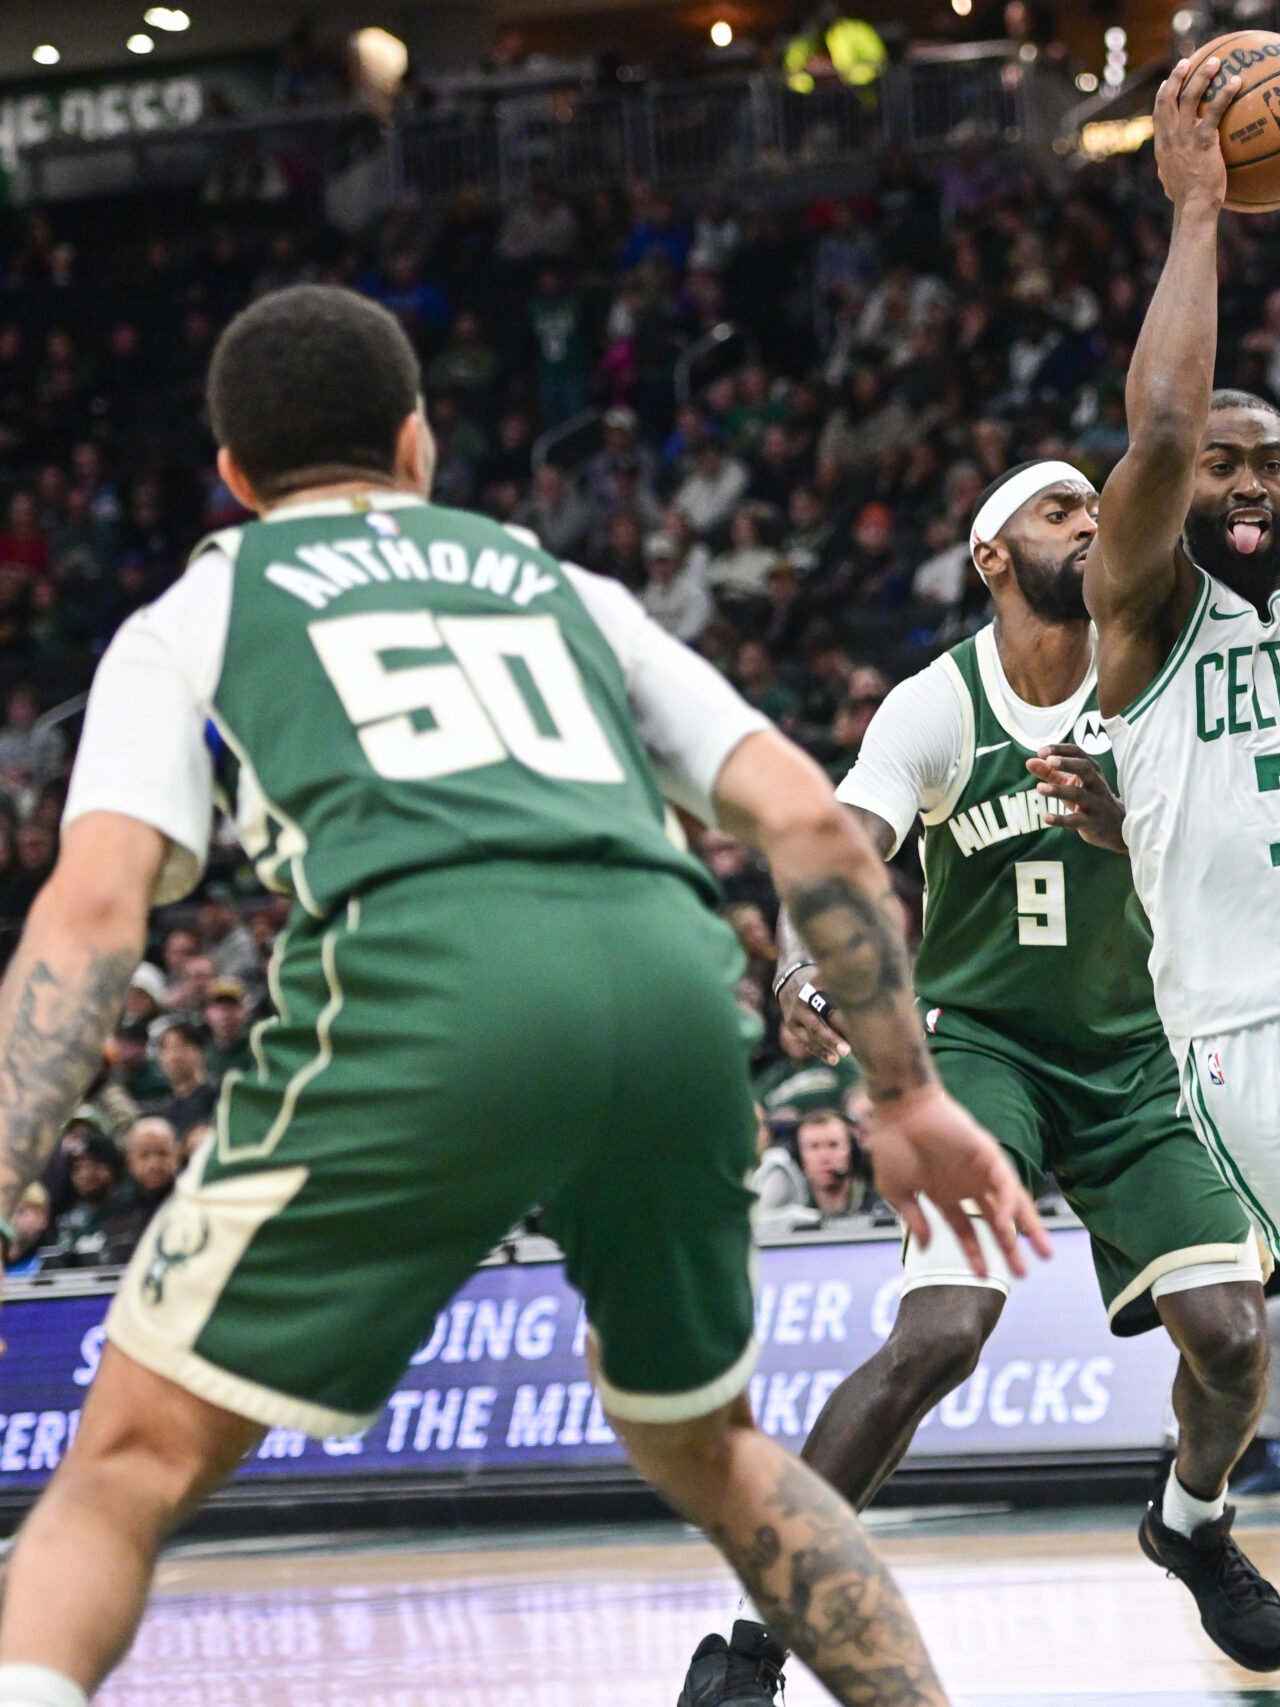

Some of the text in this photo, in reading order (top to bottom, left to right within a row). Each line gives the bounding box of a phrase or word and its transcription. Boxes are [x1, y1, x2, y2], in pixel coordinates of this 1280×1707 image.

[264, 537, 559, 610] ANTHONY
[307, 609, 627, 785] 50
[1014, 860, 1068, 947] 9
[387, 1386, 499, 1453] THE
[916, 1355, 1116, 1430] UCKS
